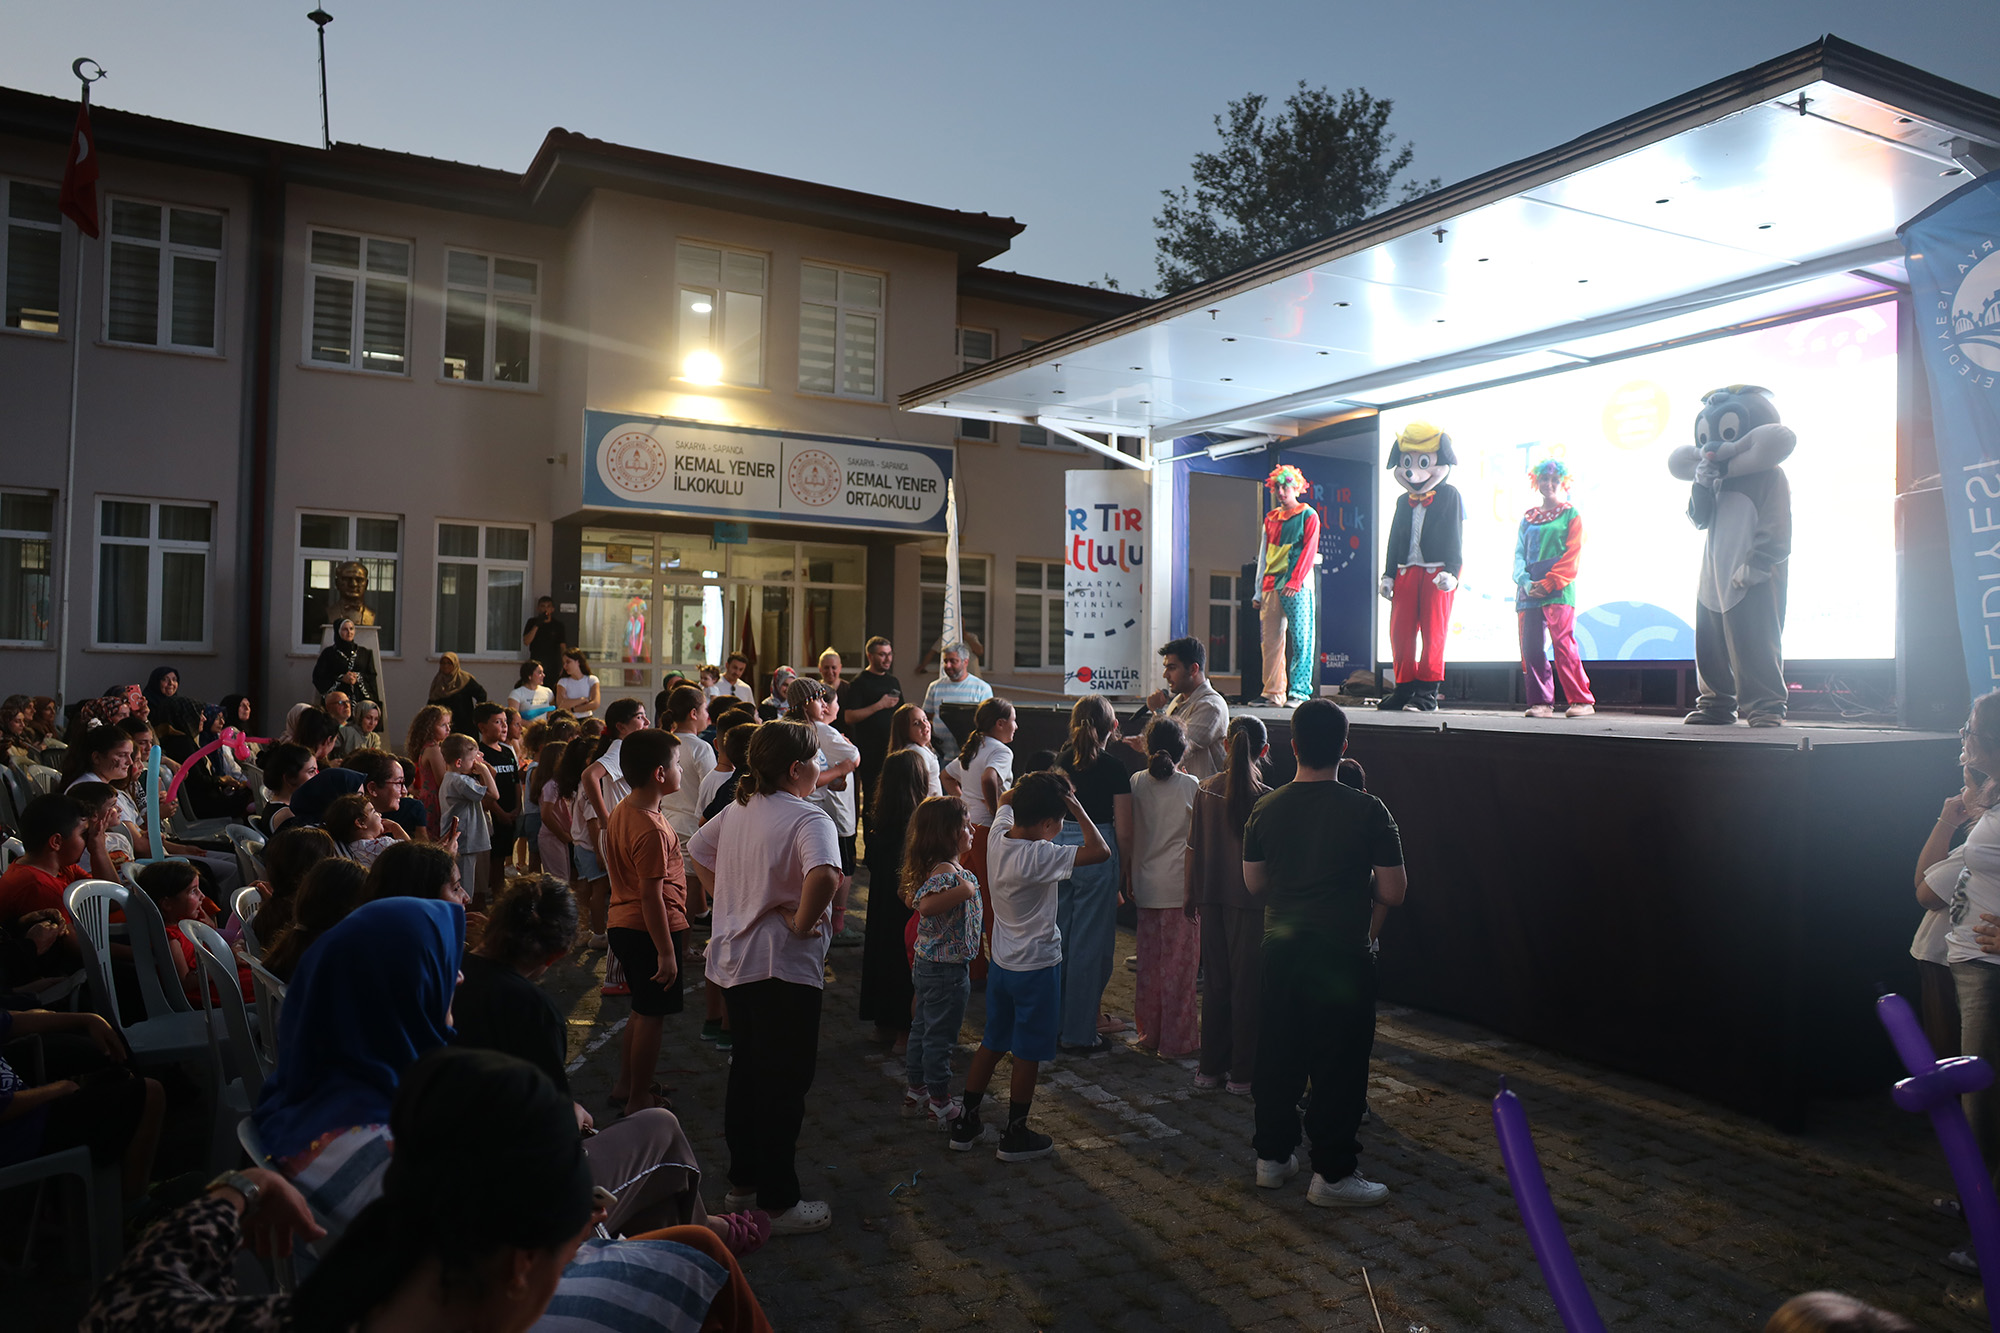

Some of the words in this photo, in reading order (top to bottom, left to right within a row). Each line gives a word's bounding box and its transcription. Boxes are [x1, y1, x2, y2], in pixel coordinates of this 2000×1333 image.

[675, 440, 706, 452] SAKARYA
[713, 444, 744, 455] SAPANCA
[674, 455, 725, 475] KEMAL
[730, 460, 775, 479] YENER
[847, 457, 875, 468] SAKARYA
[881, 461, 909, 471] SAPANCA
[674, 472, 744, 496] İLKOKULU
[846, 471, 892, 489] KEMAL
[895, 476, 937, 494] YENER
[846, 490, 921, 511] ORTAOKULU
[1067, 580, 1121, 588] AKARYA
[1065, 600, 1123, 608] TKİNLİK
[1090, 666, 1140, 680] KÜLTÜR
[1090, 680, 1130, 690] SANAT
